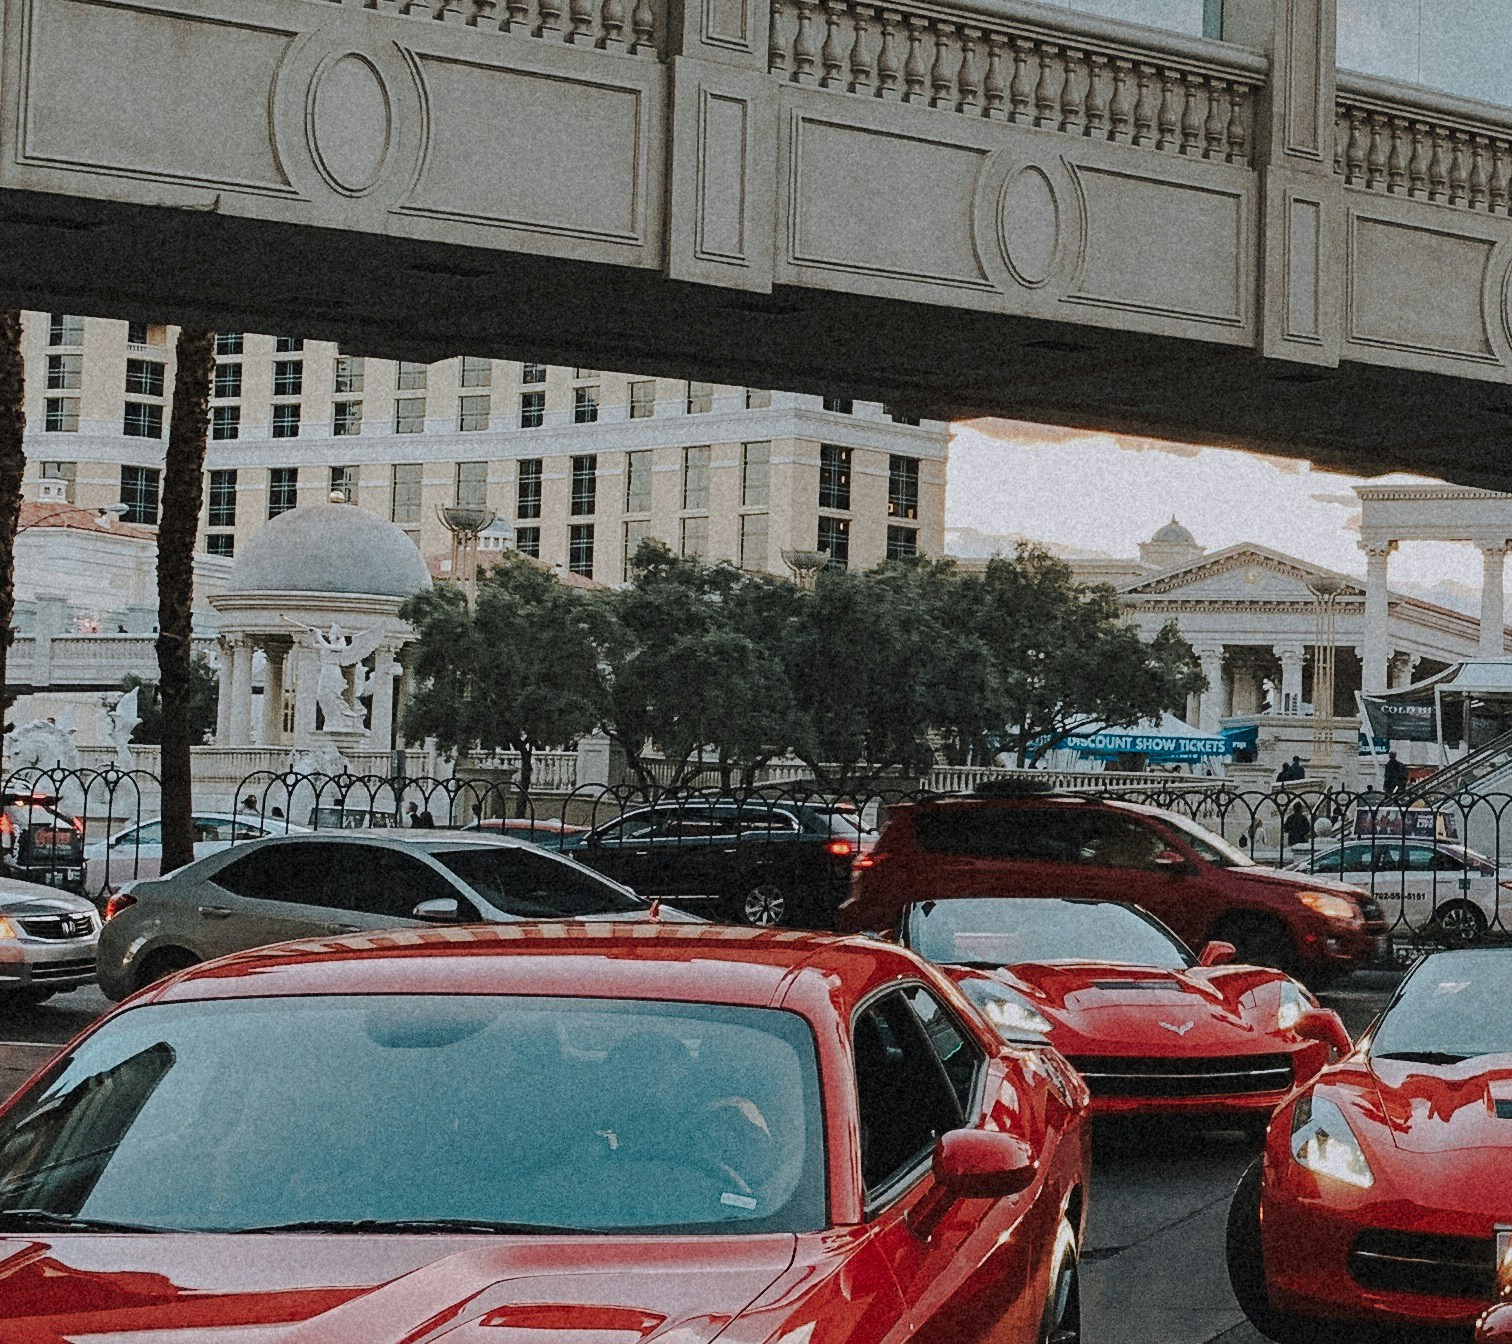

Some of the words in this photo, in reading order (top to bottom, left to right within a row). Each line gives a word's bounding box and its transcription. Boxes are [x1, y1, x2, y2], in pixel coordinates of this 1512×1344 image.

[1067, 735, 1133, 750] DISCOUNT
[1135, 737, 1176, 751] SHOW
[1179, 738, 1226, 753] TICKETS
